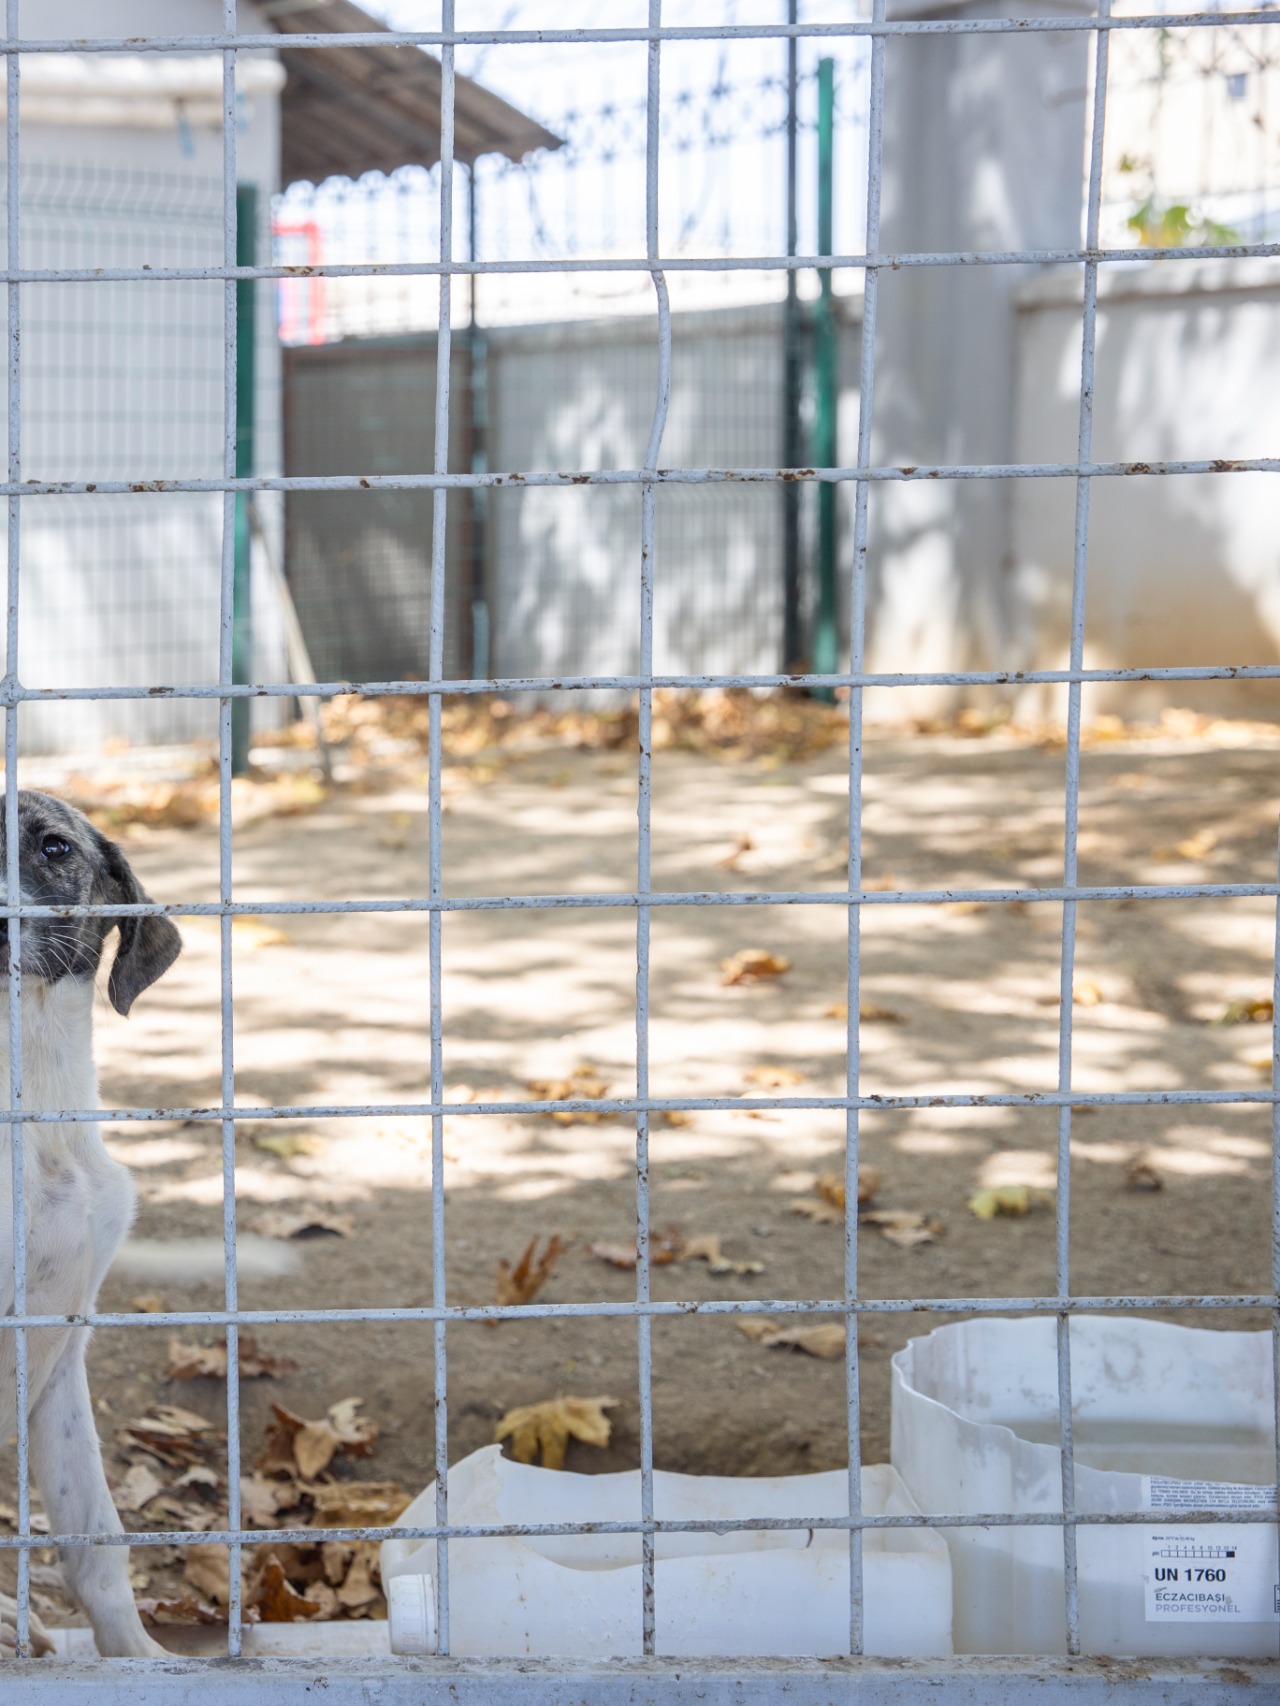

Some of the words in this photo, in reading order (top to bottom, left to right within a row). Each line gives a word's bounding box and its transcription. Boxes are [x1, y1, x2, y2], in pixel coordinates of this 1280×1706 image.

[1155, 1568, 1178, 1581] UN
[1185, 1568, 1226, 1582] 1760
[1156, 1593, 1225, 1603] ECZACIBAŞI
[1156, 1604, 1240, 1612] PROFESYONEL
